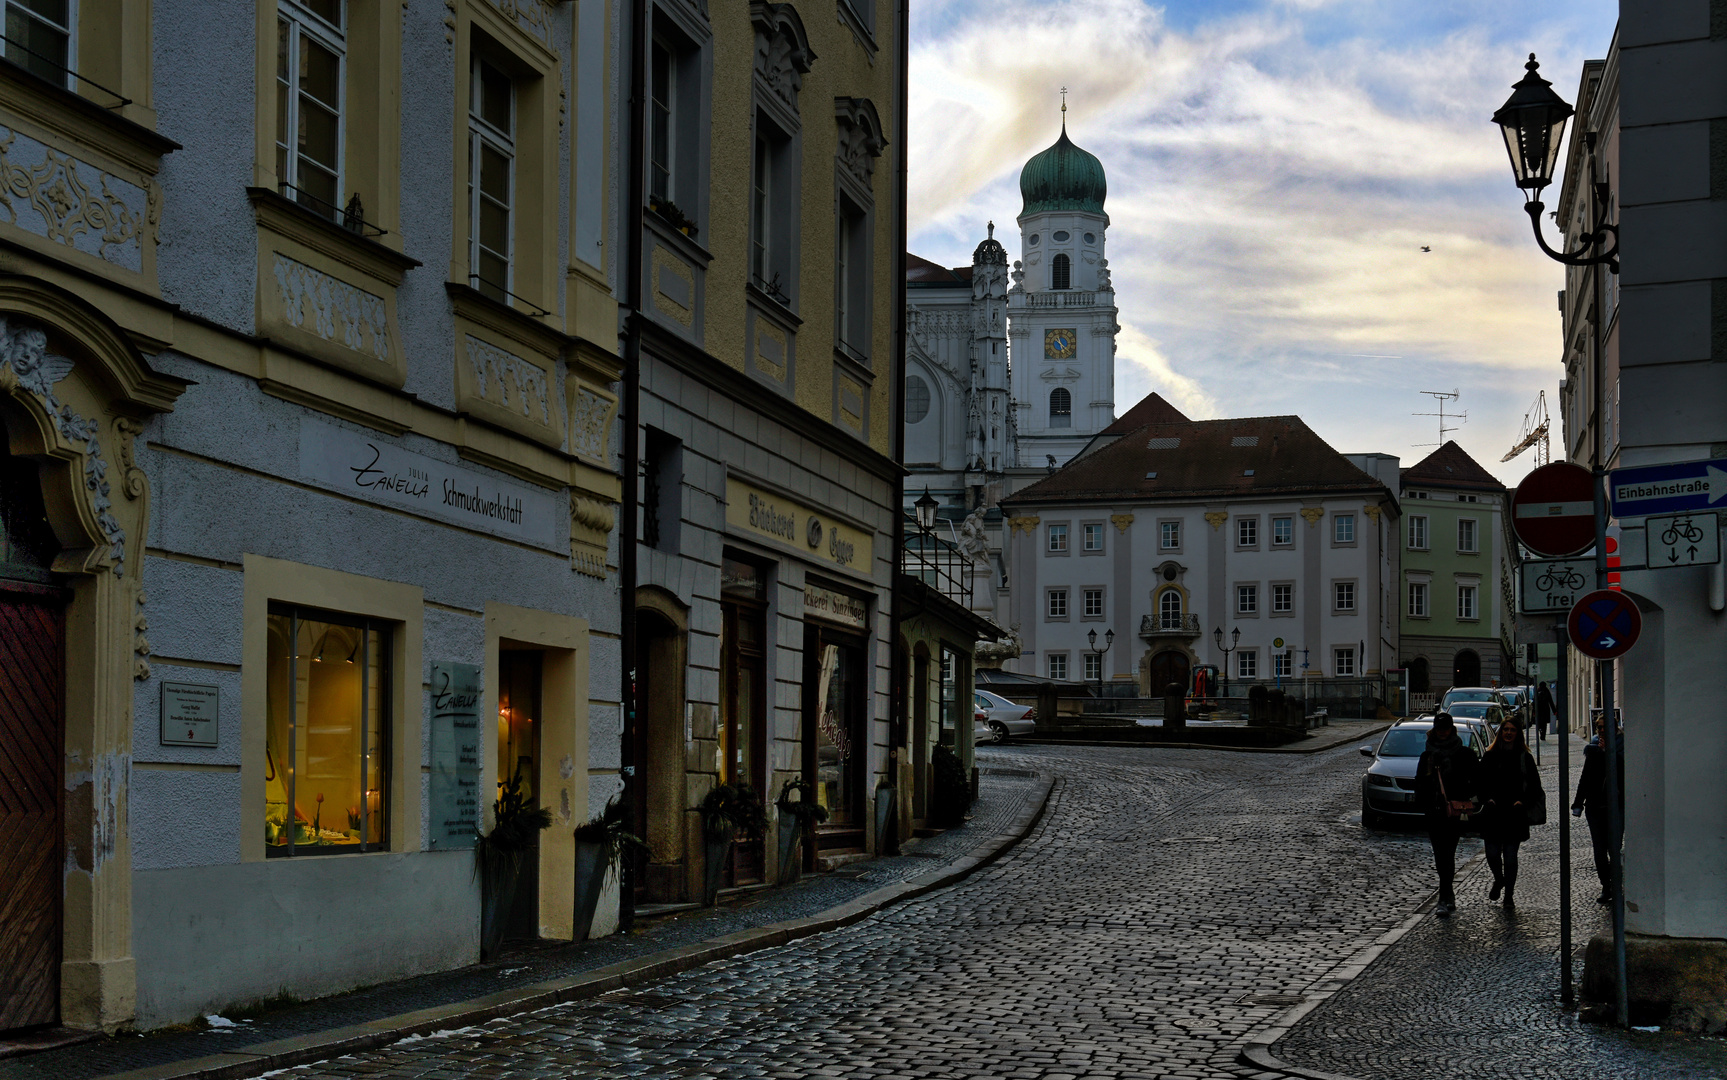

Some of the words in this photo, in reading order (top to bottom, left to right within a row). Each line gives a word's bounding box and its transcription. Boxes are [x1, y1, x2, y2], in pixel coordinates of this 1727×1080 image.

[350, 443, 428, 499] ZANELLA
[443, 478, 522, 525] Schmuckwerkstatt
[408, 467, 429, 482] JULIA
[1617, 480, 1710, 499] Einbahnstraße
[832, 595, 865, 622] Sinzinger
[1546, 591, 1575, 607] frei
[432, 672, 478, 710] ZANELLA
